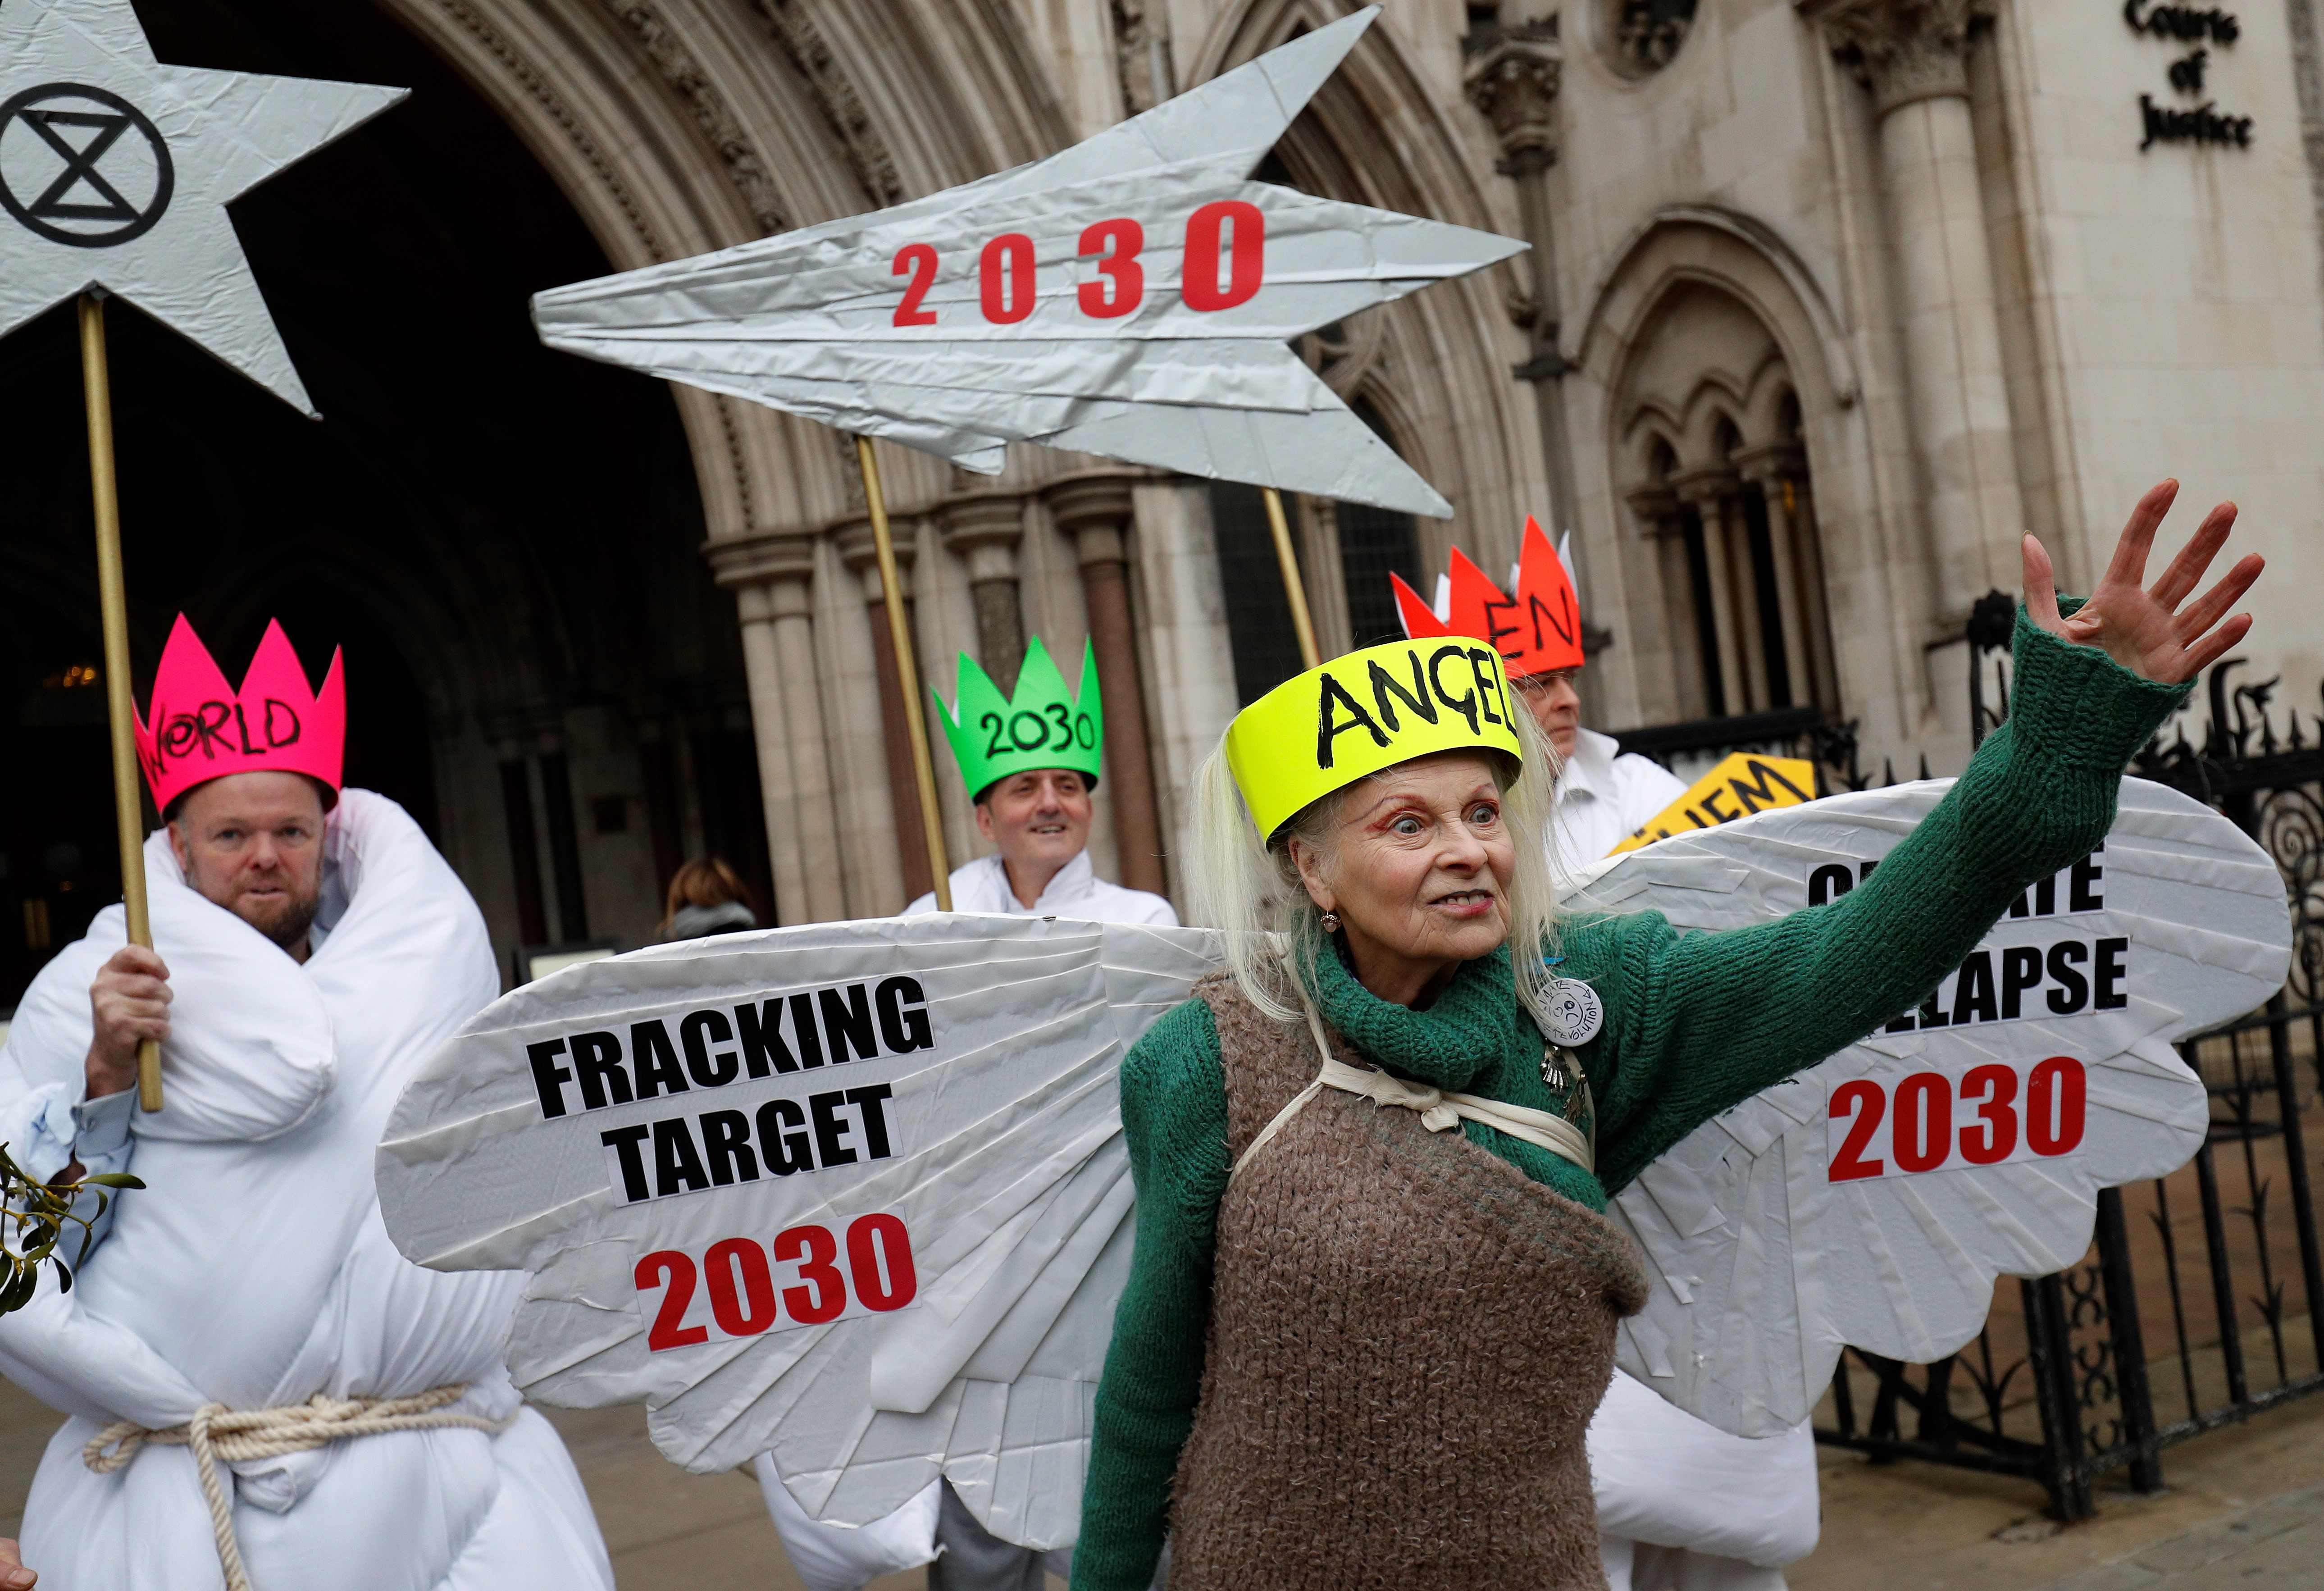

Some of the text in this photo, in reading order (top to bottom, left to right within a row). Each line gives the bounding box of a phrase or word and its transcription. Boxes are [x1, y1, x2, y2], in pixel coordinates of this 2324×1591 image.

[893, 201, 1264, 327] 2030
[135, 699, 301, 786] WORLD
[981, 704, 1094, 759] 2030
[526, 976, 934, 1119] FRACKING
[600, 1082, 893, 1203] TARGET
[1828, 1056, 2086, 1182] 2030
[634, 1213, 917, 1351] 2030
